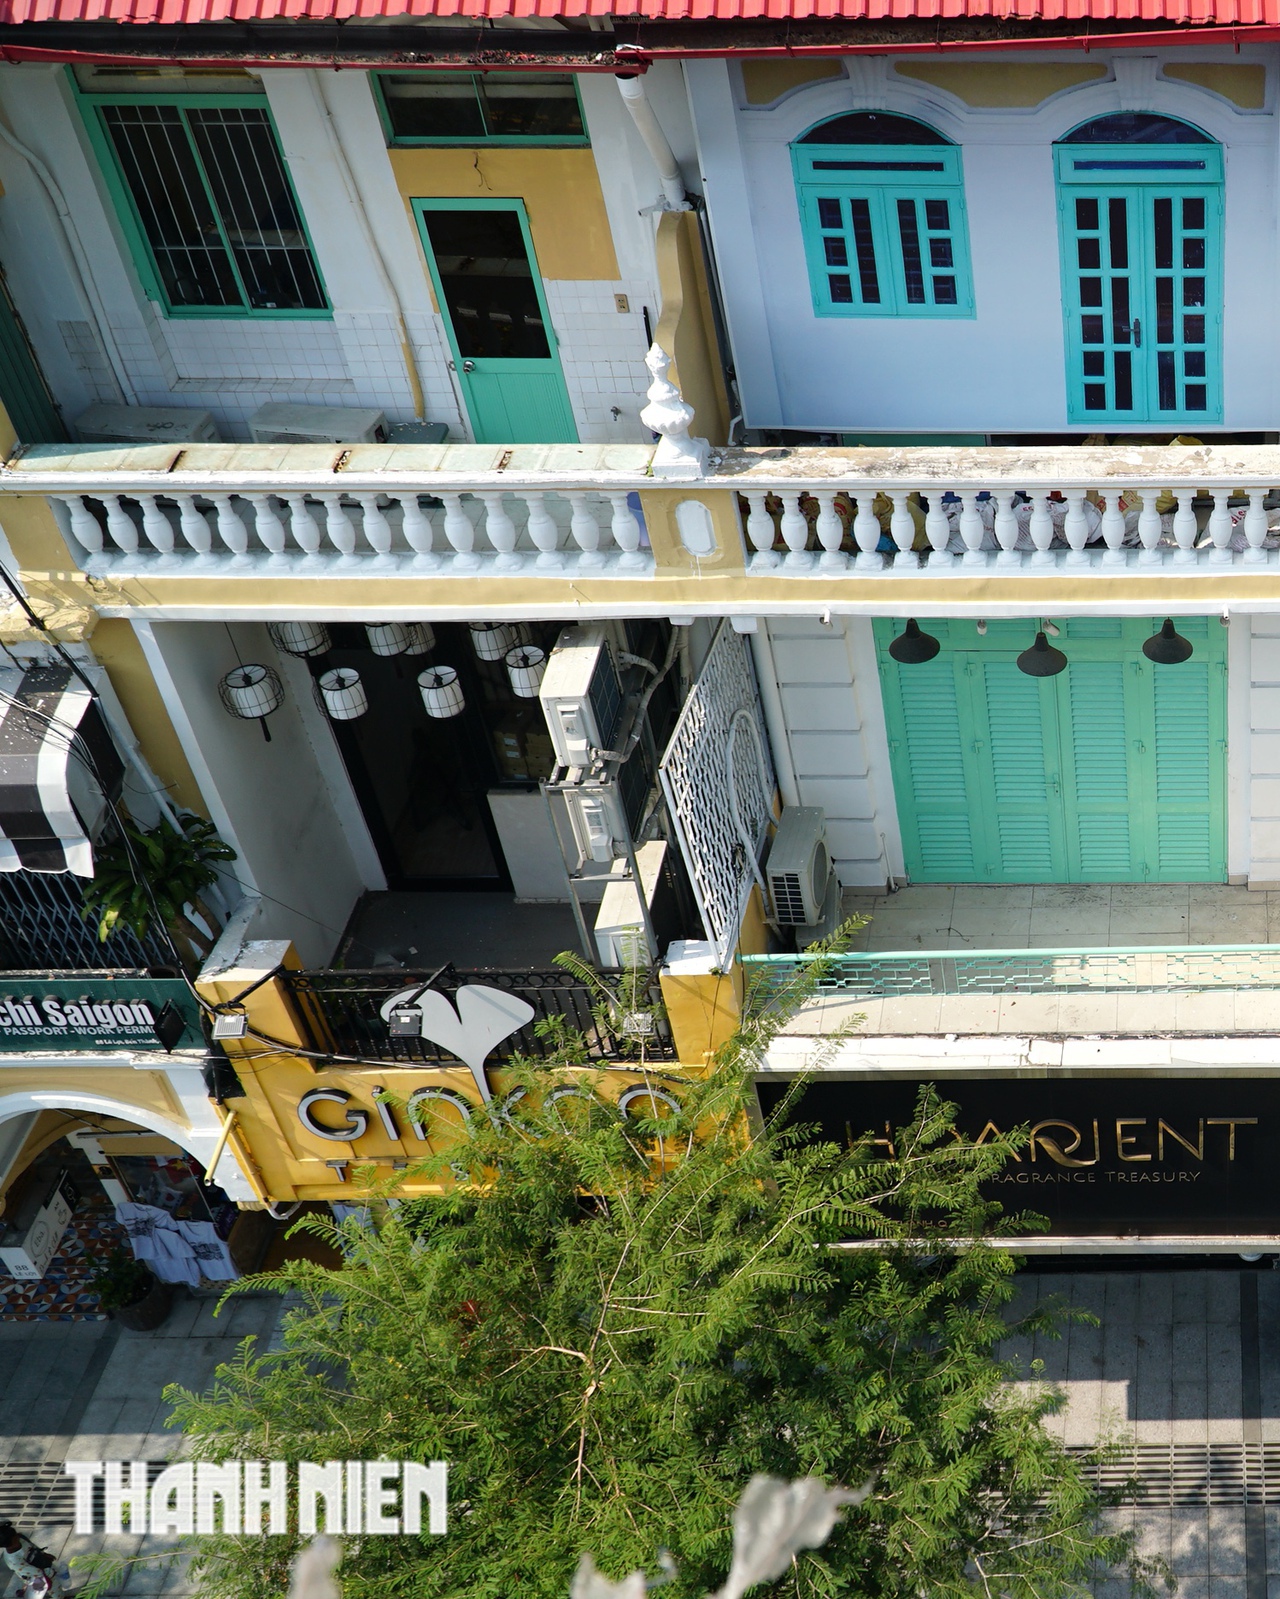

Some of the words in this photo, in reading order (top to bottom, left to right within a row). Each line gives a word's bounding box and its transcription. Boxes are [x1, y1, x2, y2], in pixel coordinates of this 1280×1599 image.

[42, 1000, 155, 1029] Saigon
[846, 1117, 1259, 1168] HARIENT
[982, 1171, 1096, 1184] RAGRANCE
[1104, 1170, 1202, 1183] TREASURY
